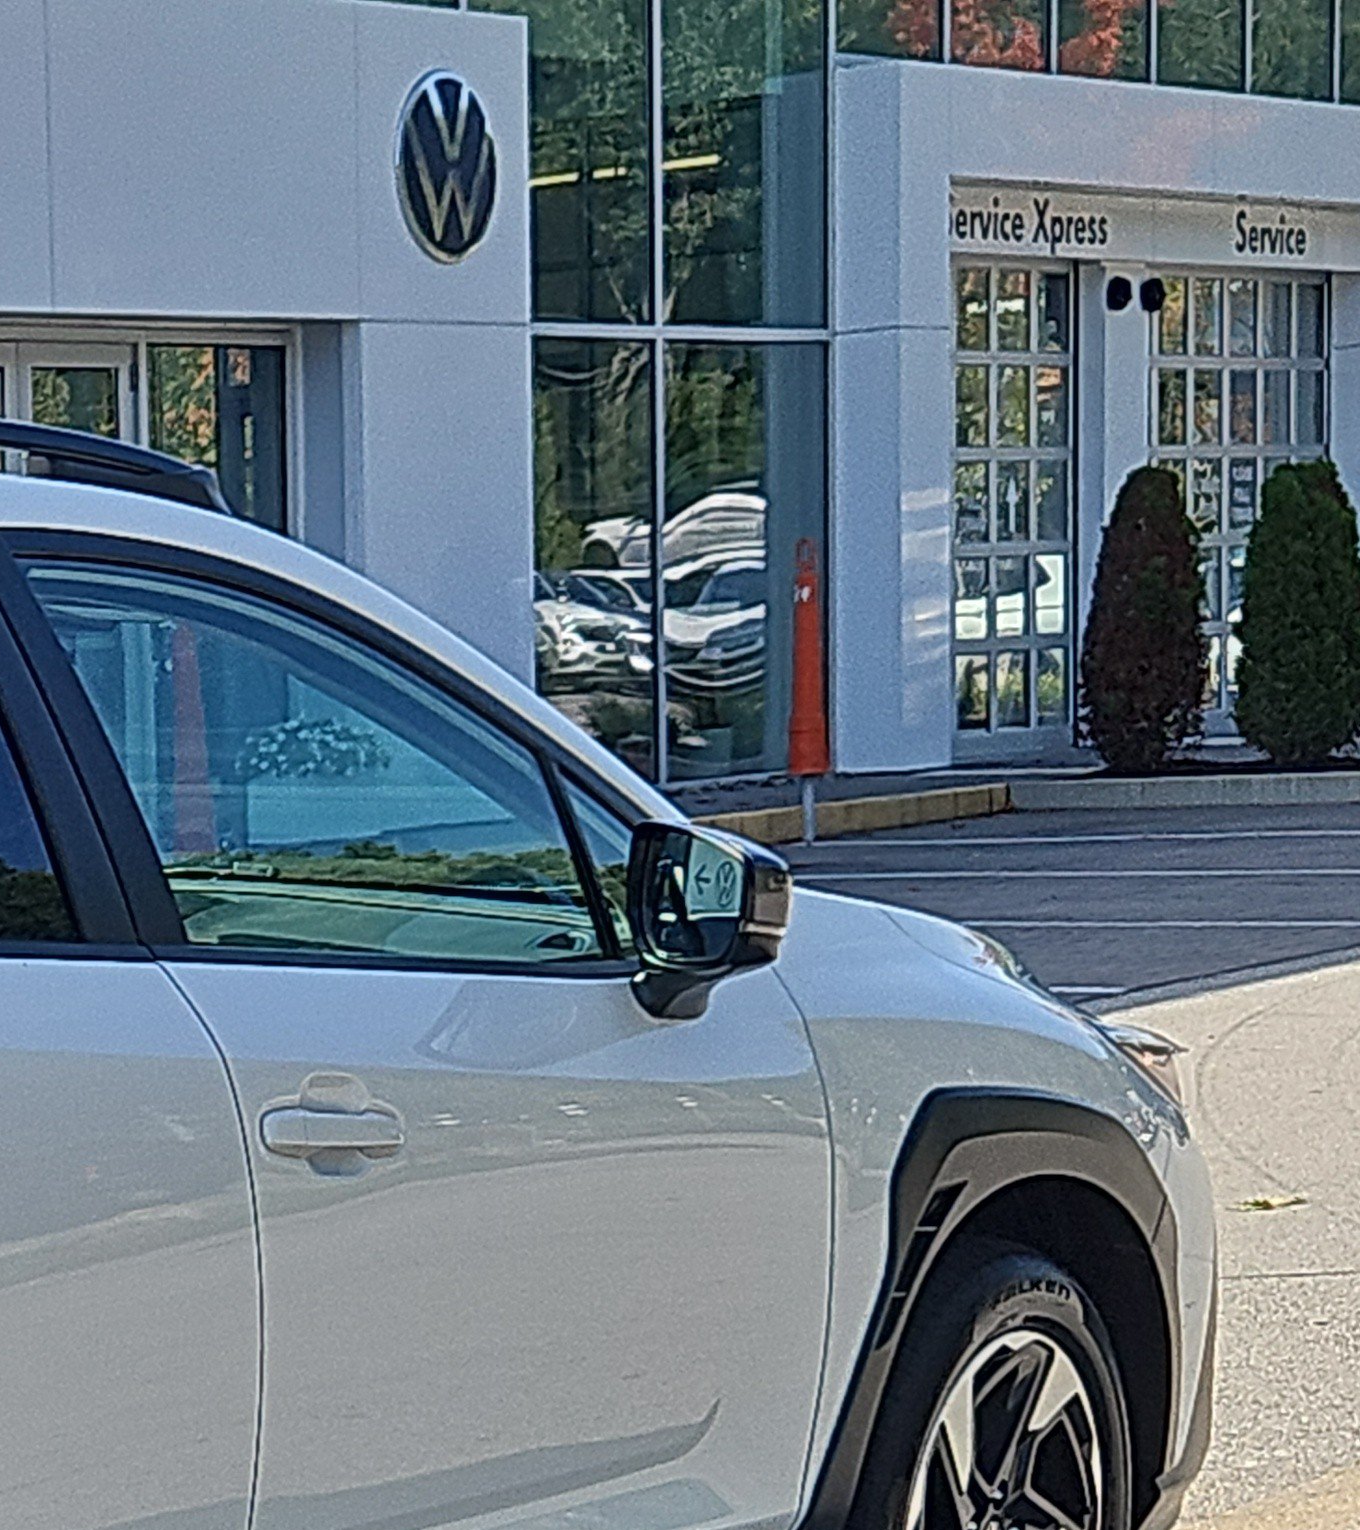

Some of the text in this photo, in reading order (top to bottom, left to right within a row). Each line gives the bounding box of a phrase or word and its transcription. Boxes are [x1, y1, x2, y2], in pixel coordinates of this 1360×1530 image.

[949, 194, 1108, 255] ervice Xpress
[1234, 209, 1306, 255] Service
